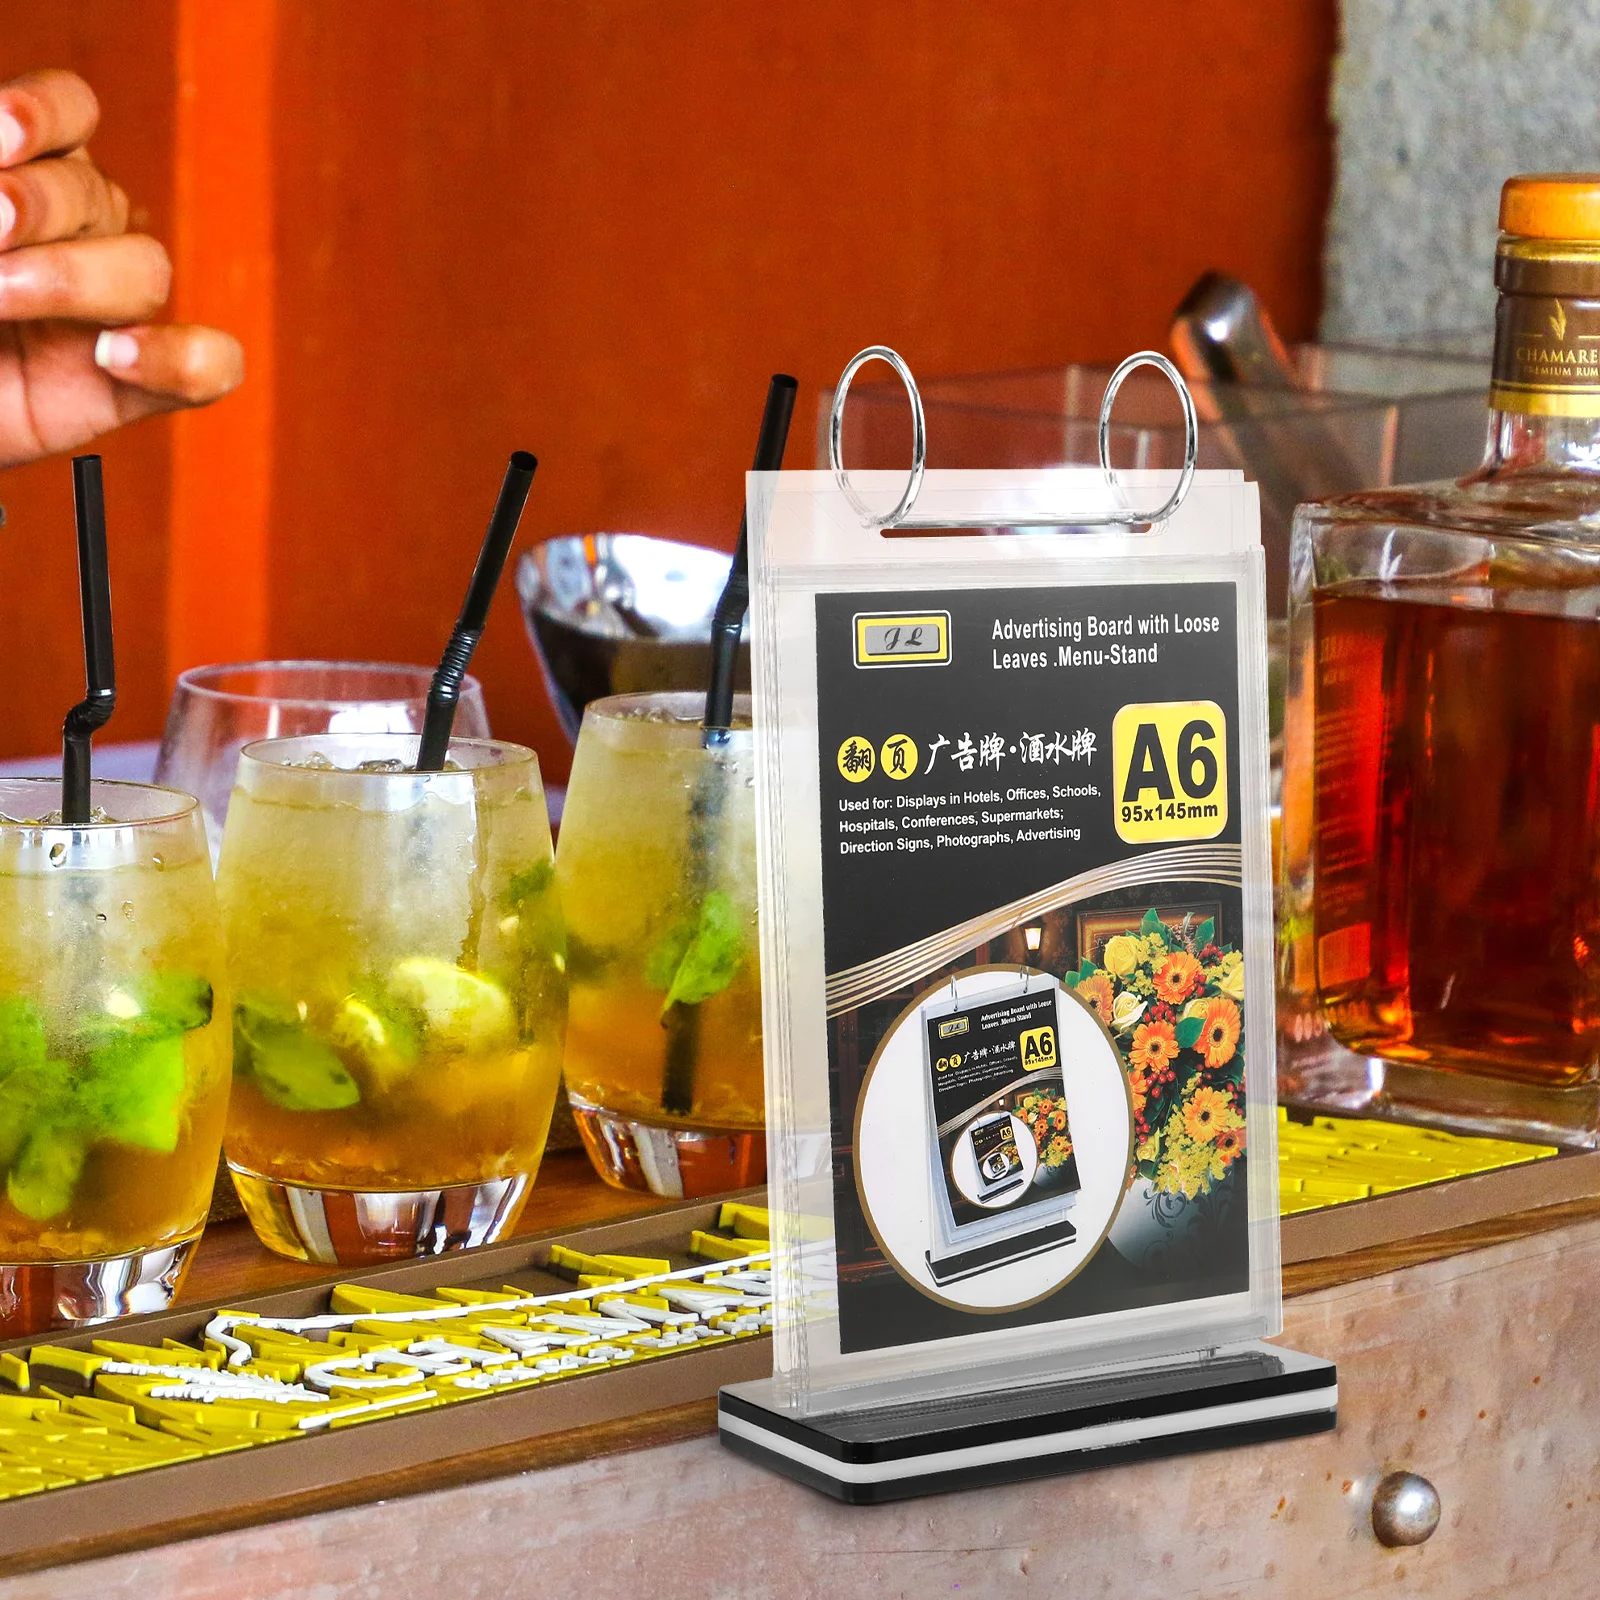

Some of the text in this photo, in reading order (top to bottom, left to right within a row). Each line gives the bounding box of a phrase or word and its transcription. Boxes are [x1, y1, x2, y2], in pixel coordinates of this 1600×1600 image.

[1516, 347, 1600, 364] CHAMARE
[1576, 366, 1599, 377] RUM
[992, 613, 1220, 642] Advertising Board with Loose
[992, 649, 1048, 669] Leaves
[1122, 719, 1218, 802] A6
[839, 784, 1101, 811] Used for: Displays in Hotels, Offices, Schools,
[839, 808, 1064, 834] Hospitals, Conferences, Supermarkets;
[1121, 803, 1218, 822] 95x145mm
[840, 827, 1081, 855] Direction Signs, Photographs, Advertising
[1025, 1032, 1052, 1059] A6
